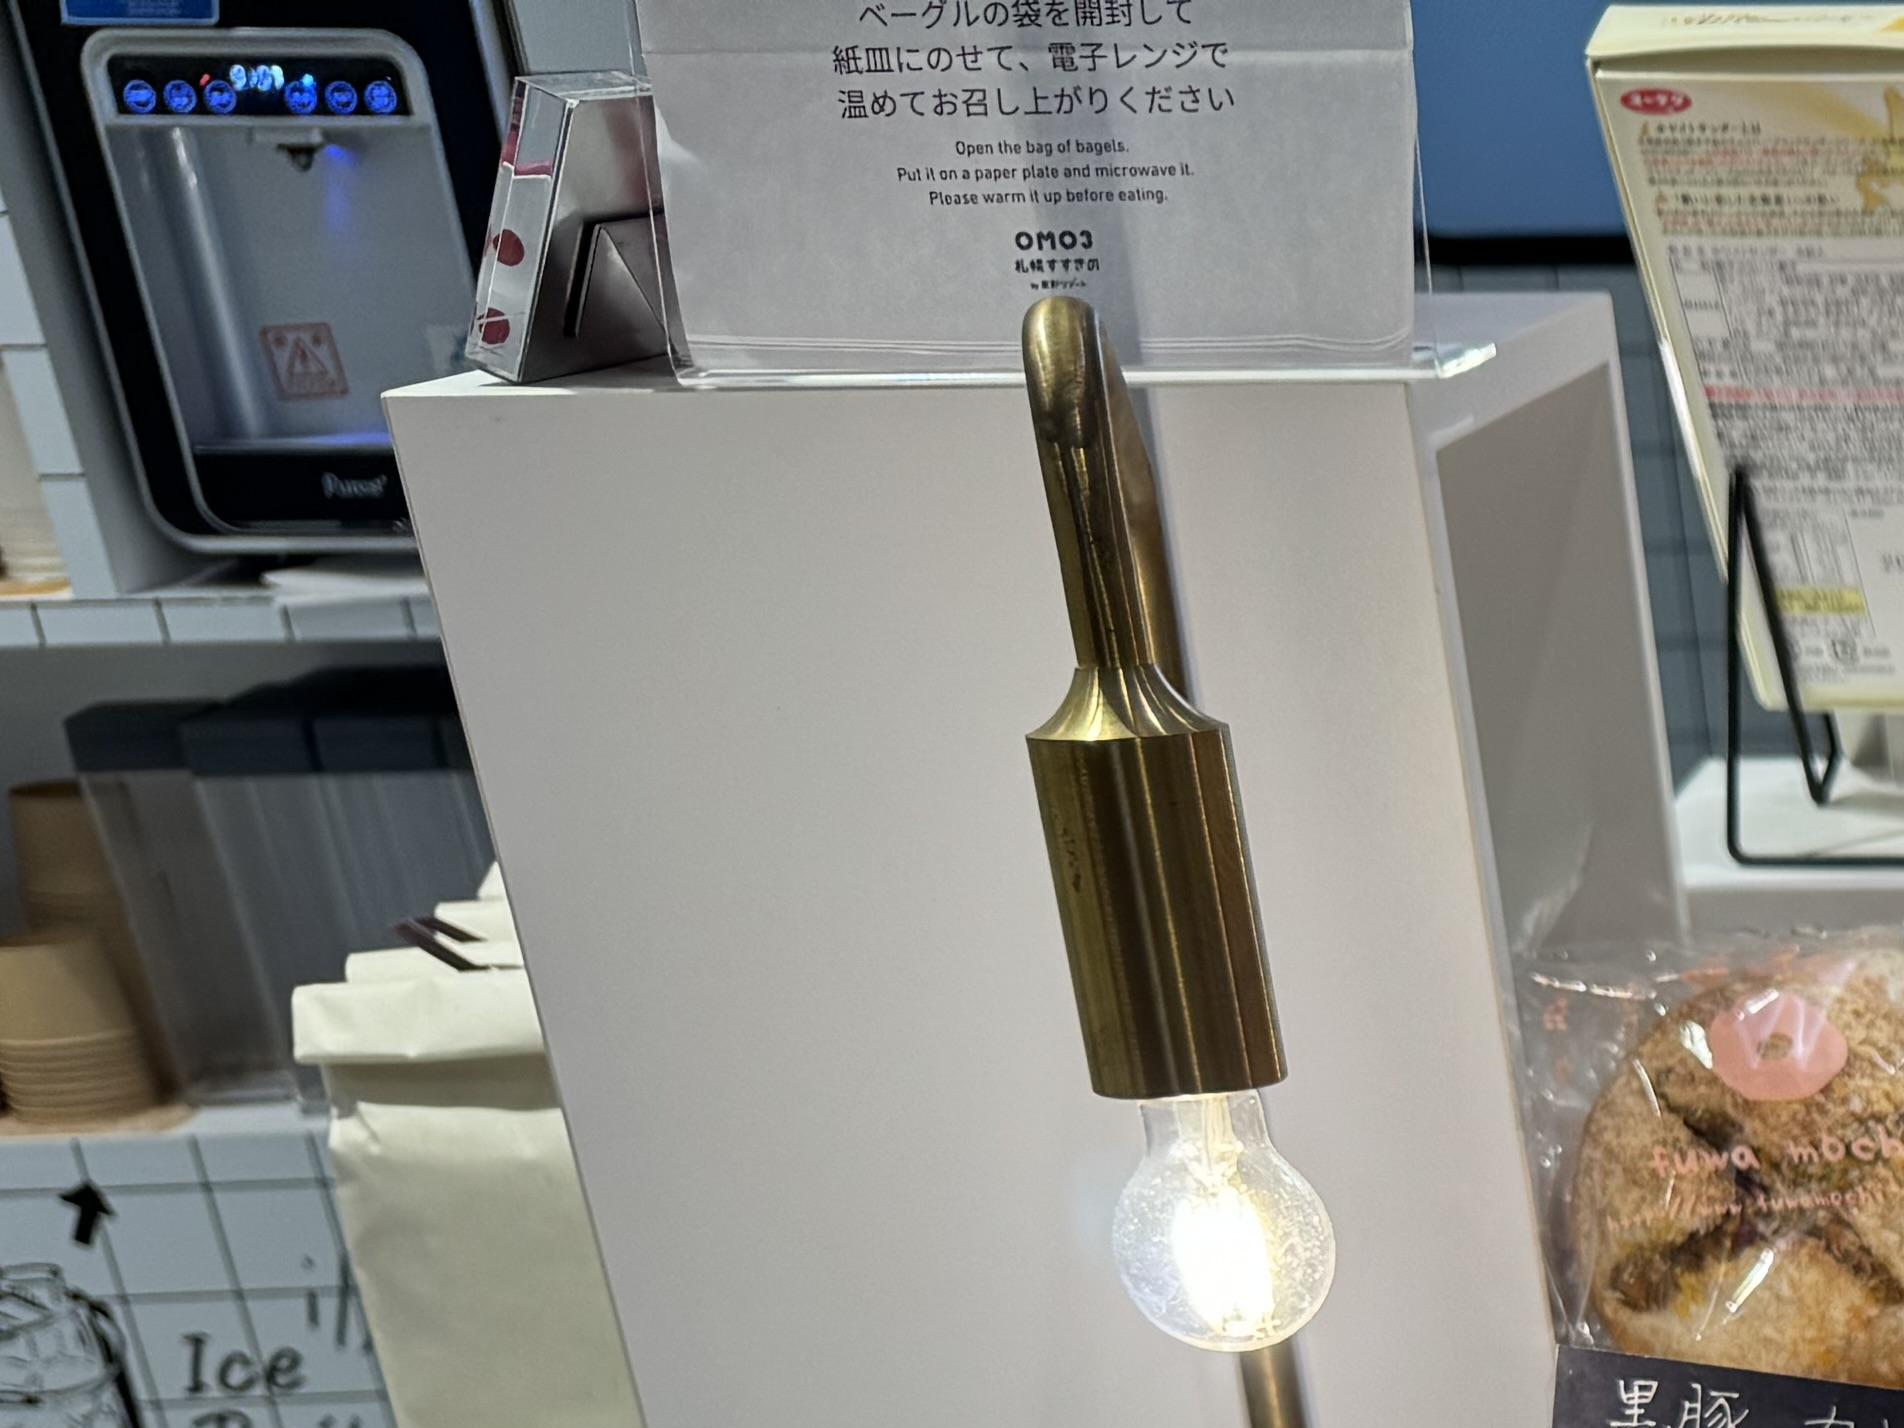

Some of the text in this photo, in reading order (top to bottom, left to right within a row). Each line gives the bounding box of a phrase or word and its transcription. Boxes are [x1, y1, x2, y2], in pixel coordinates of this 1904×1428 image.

[859, 0, 1193, 28] ベーグルの袋を開封して
[833, 42, 1230, 75] 紙皿にのせて、電子レンジで
[838, 86, 1235, 118] 温めてお召し上がりください
[956, 140, 1129, 157] Open the bag of bagels.
[898, 168, 921, 181] Put
[926, 168, 935, 180] it
[940, 171, 957, 180] on
[962, 171, 970, 180] a
[975, 169, 1017, 182] paper
[1022, 166, 1059, 180] plate
[1064, 166, 1090, 178] and
[1095, 165, 1176, 177] microwave
[929, 189, 1168, 205] Please warm it up before eating.
[1015, 230, 1093, 250] OMO3
[184, 1331, 305, 1394] Ice
